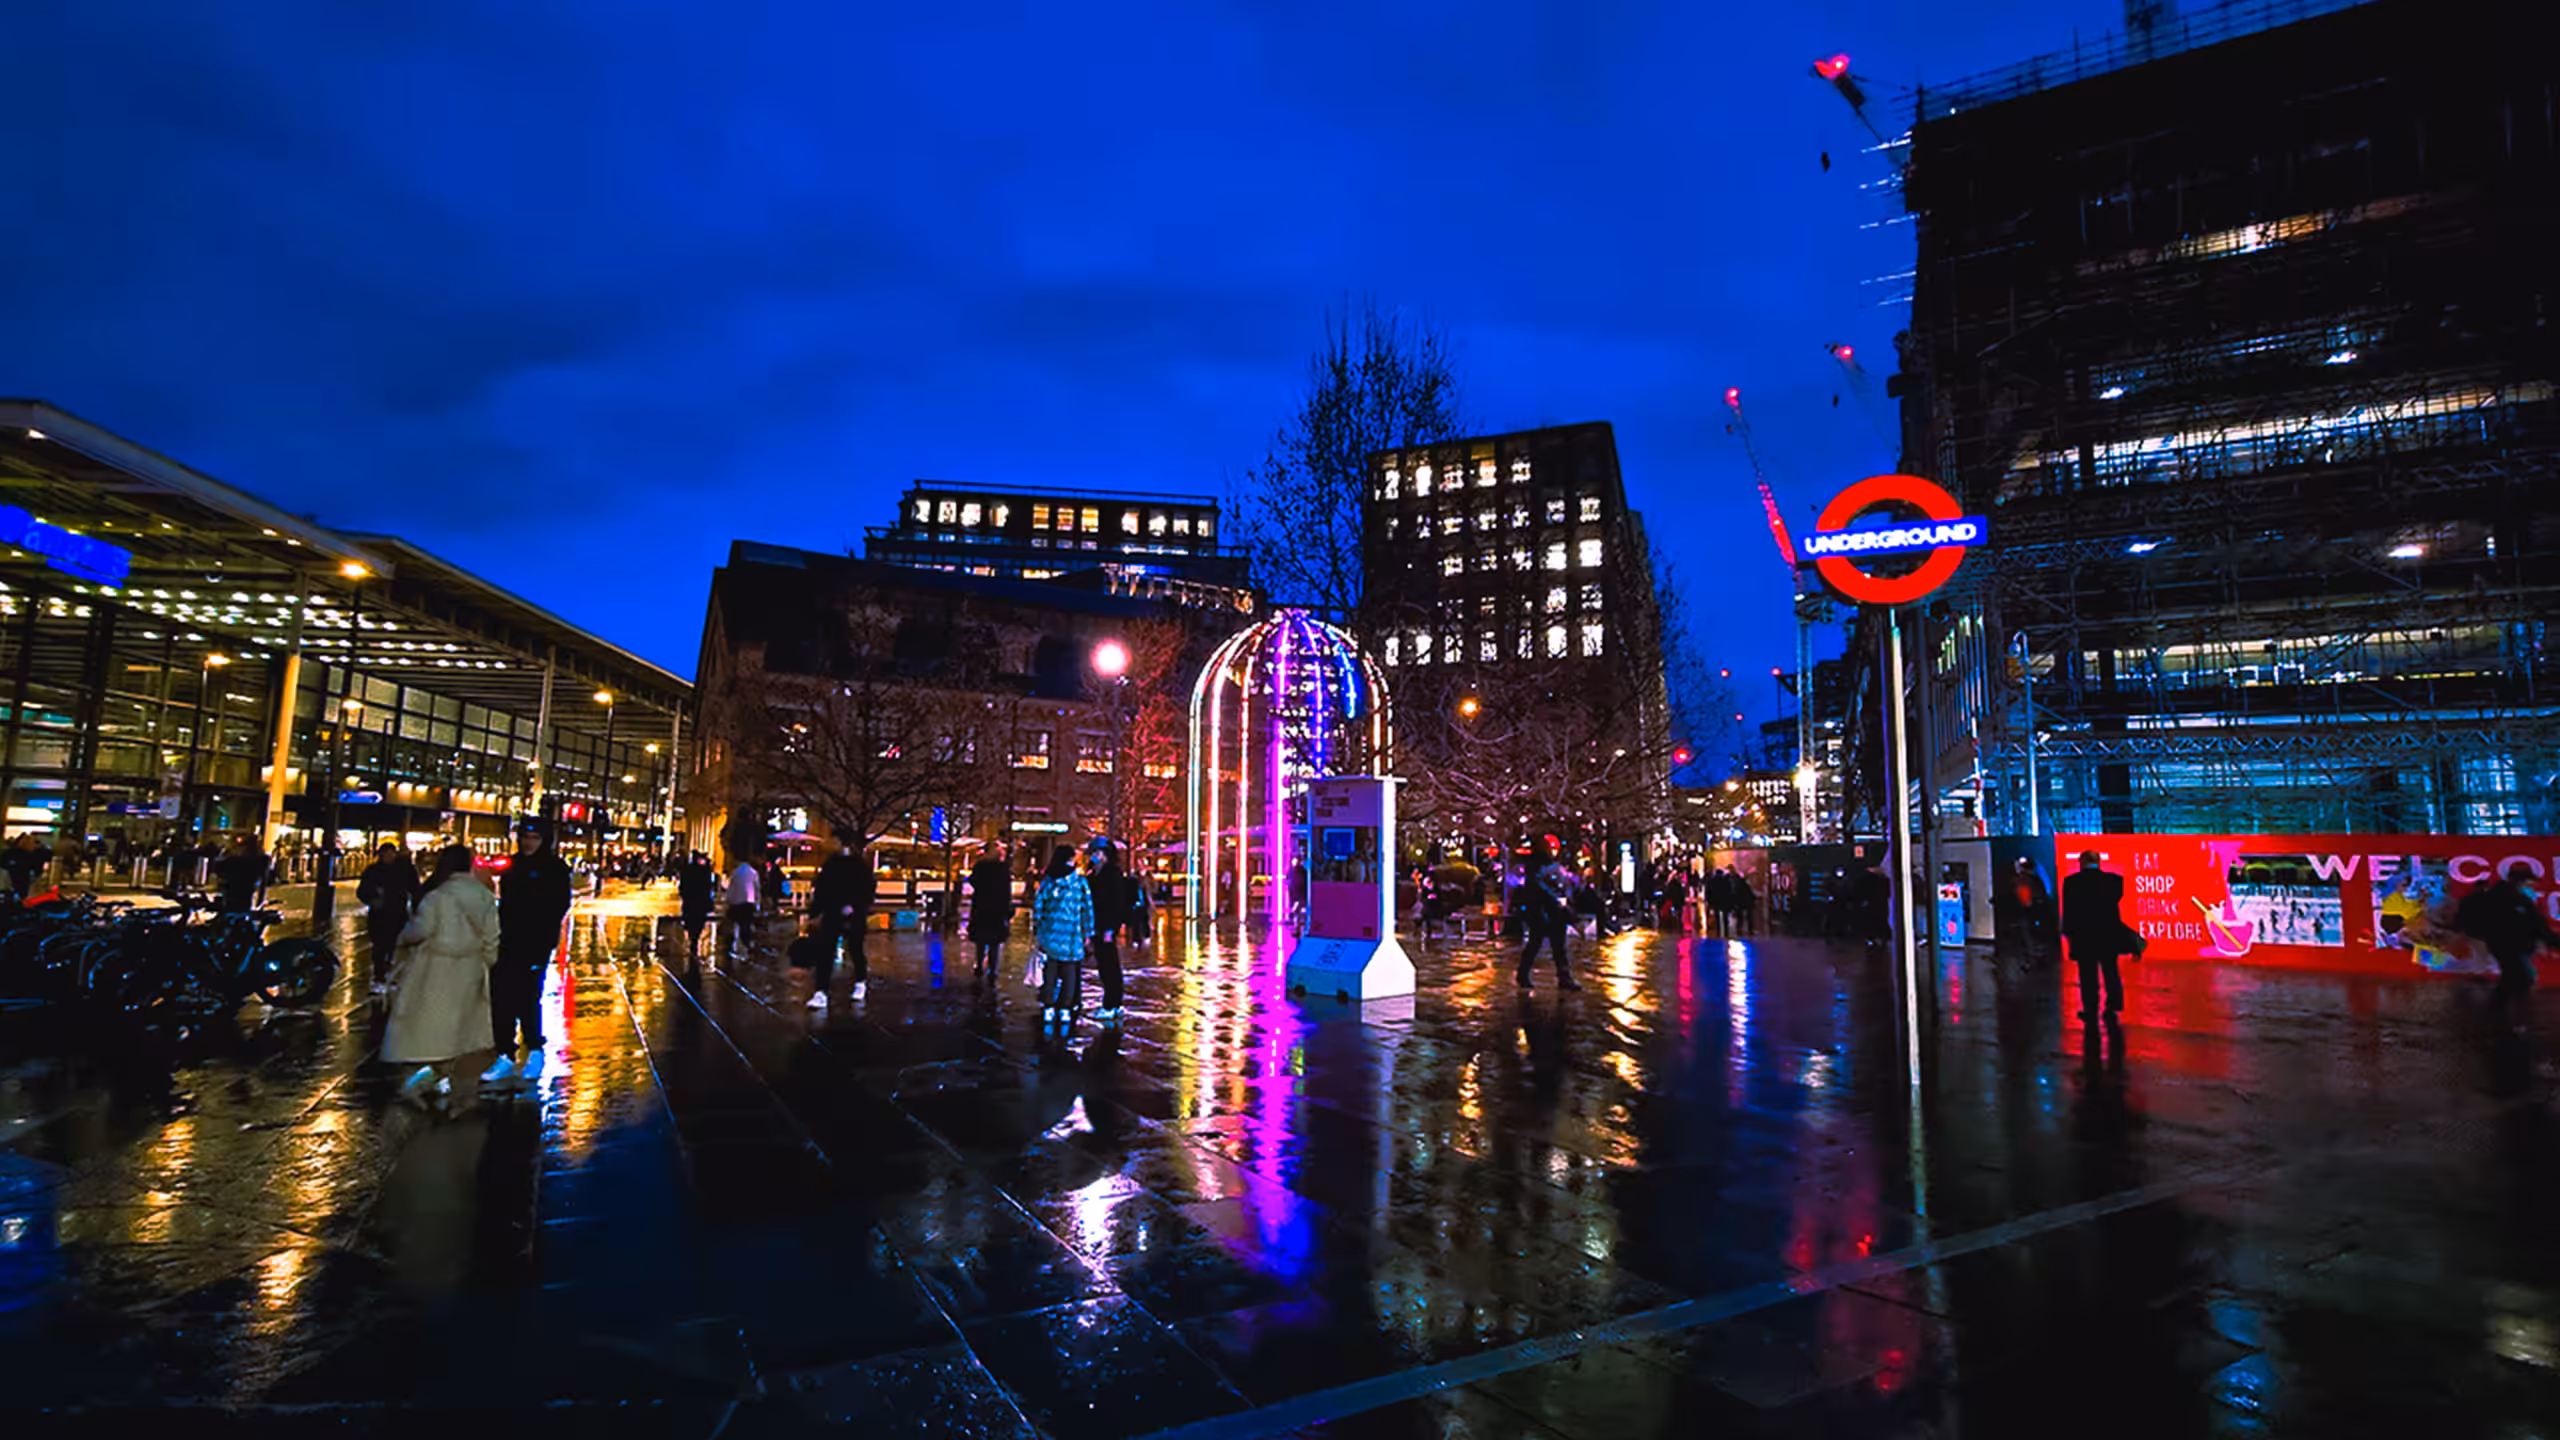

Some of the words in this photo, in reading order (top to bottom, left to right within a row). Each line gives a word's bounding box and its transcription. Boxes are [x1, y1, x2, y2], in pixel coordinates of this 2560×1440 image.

[1804, 523, 1977, 554] UNDERGROUND
[2134, 852, 2160, 871] EAT
[2306, 854, 2560, 885] WELCO
[2135, 875, 2176, 893] SHOP
[2137, 897, 2180, 917] DRINK
[2138, 920, 2203, 941] EXPLORE
